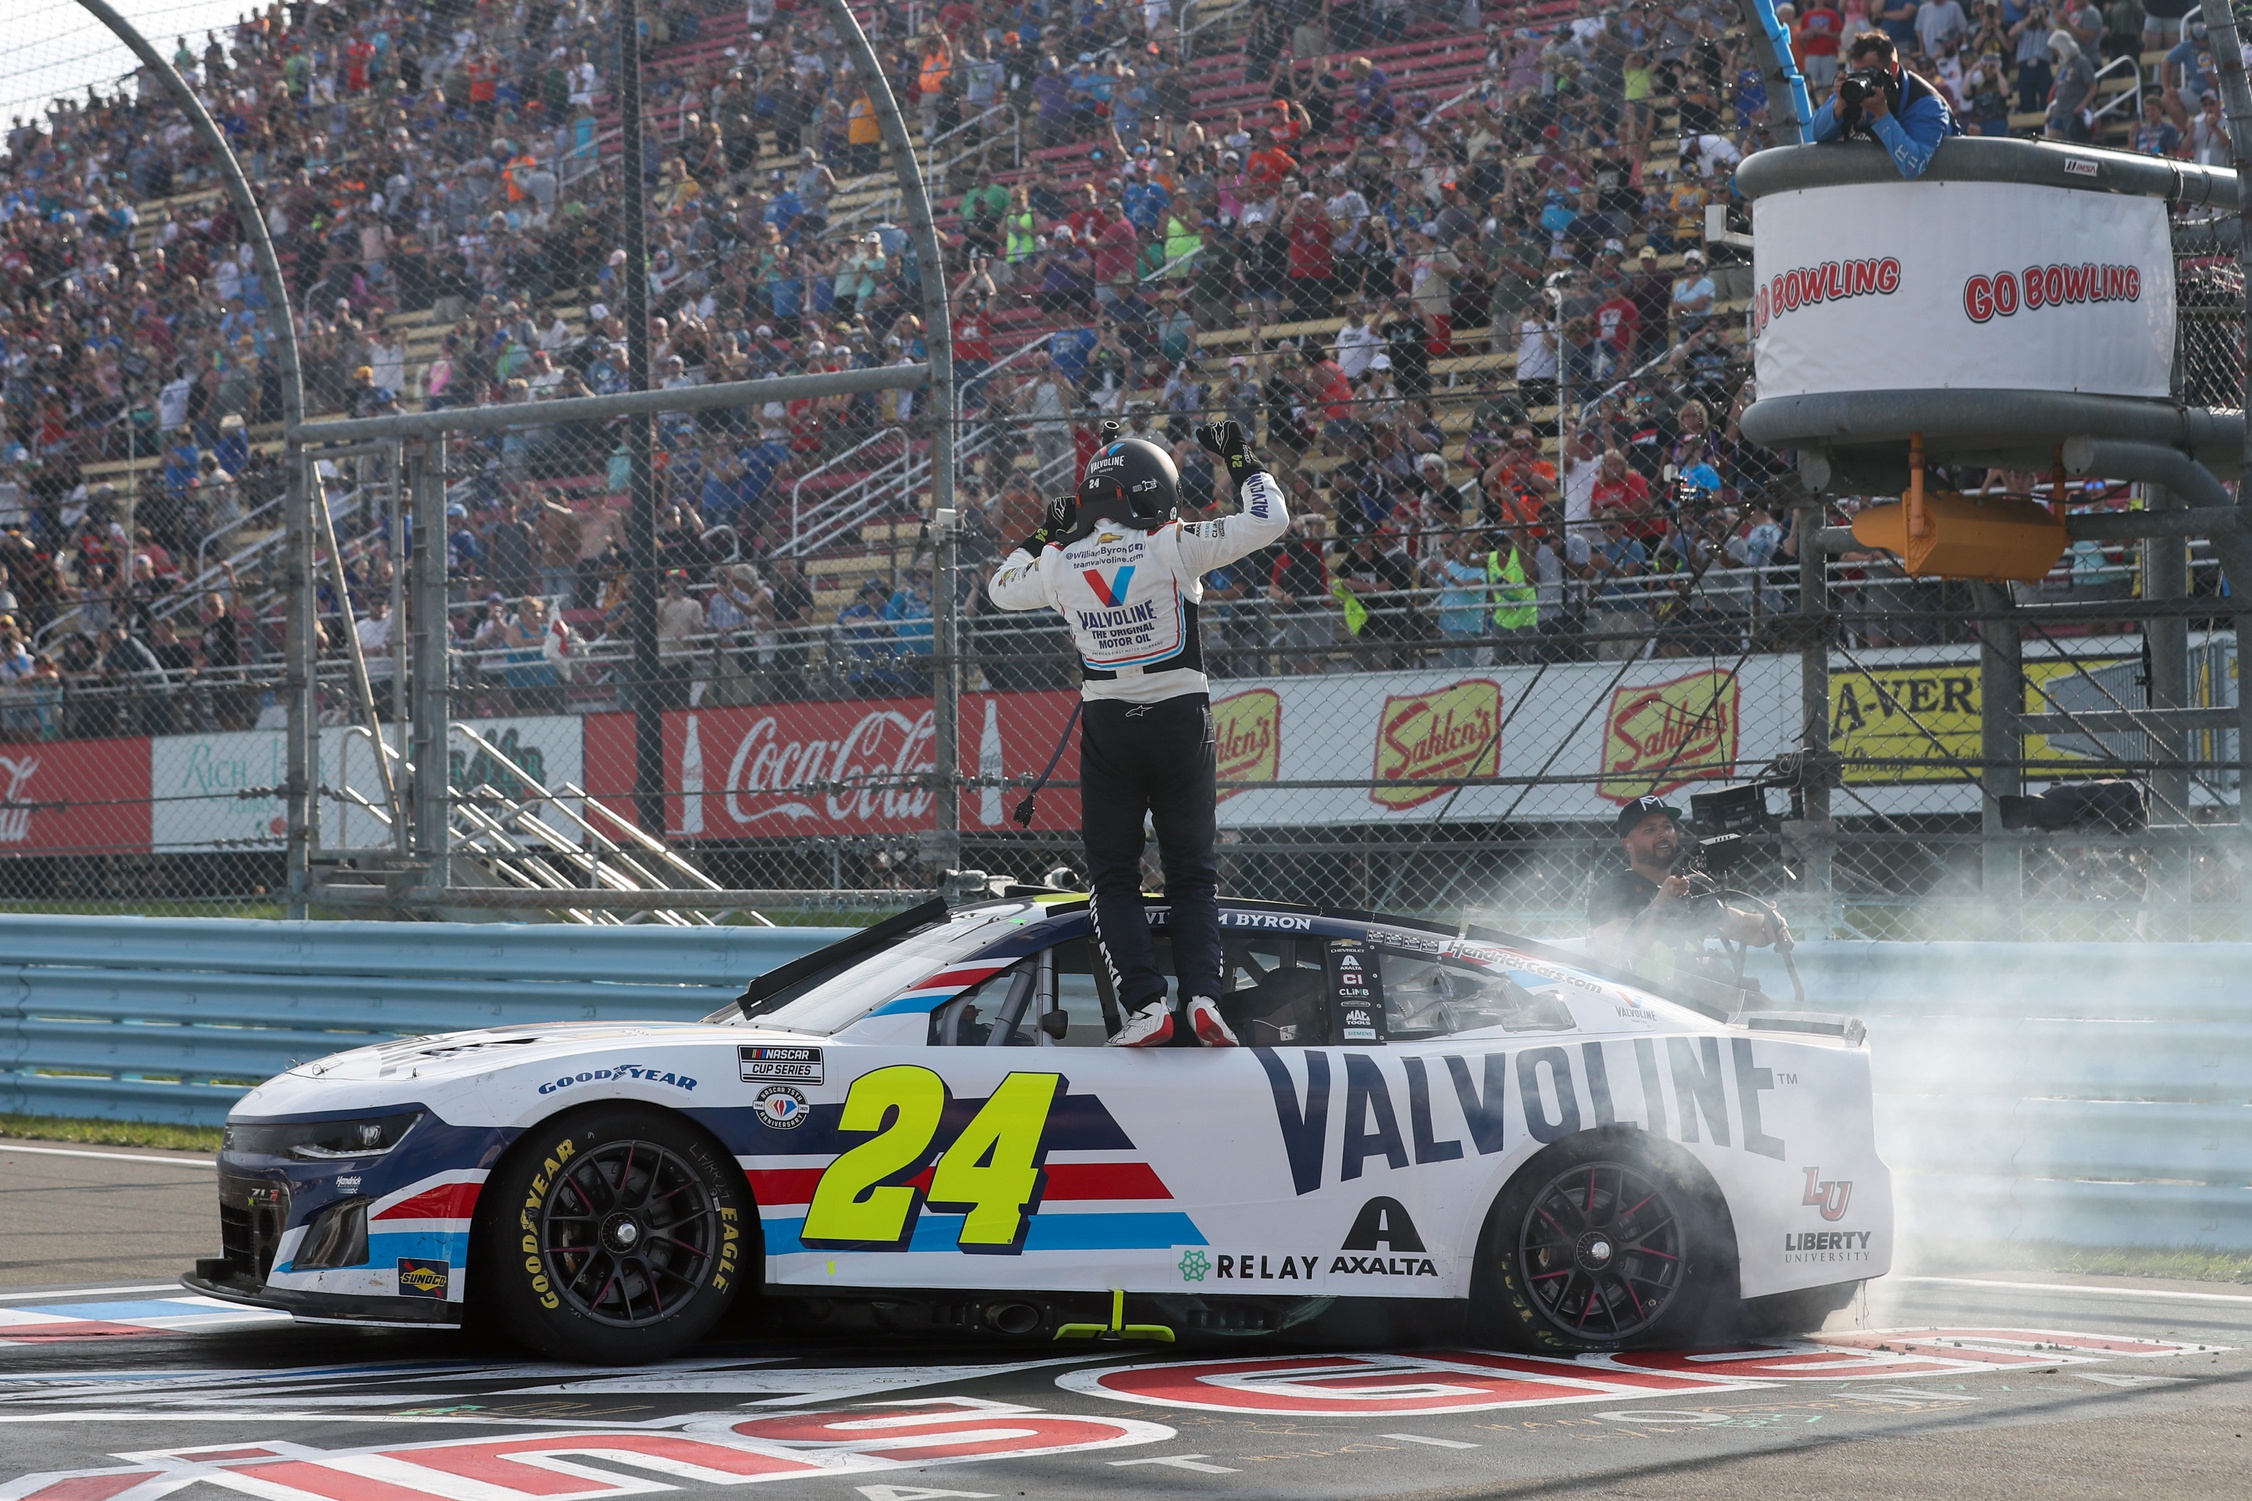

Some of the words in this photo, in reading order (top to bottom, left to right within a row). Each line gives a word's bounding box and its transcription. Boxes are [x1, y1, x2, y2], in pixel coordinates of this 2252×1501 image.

[1771, 256, 1901, 319] BOWLING
[1963, 270, 2020, 324] GO
[2021, 261, 2141, 311] BOWLING
[1090, 455, 1125, 474] VALVOLINE
[1231, 454, 1243, 468] 24
[1089, 478, 1100, 489] 24
[1035, 528, 1048, 543] 24
[1076, 599, 1157, 630] VALVOLINE
[1092, 629, 1107, 640] THE
[1110, 622, 1155, 638] ORIGINAL
[1098, 636, 1133, 649] MOTOR
[1135, 633, 1152, 644] OIL
[1382, 701, 1492, 779] Sahlen's
[1234, 912, 1312, 931] BYRON
[1446, 940, 1603, 994] HendrickCars.com
[1343, 973, 1364, 985] CI
[1346, 1010, 1371, 1021] MAC
[1615, 1004, 1657, 1022] VALVOLINE
[1140, 1020, 1152, 1033] 24
[765, 1049, 810, 1060] NASCAR
[752, 1063, 774, 1074] CUP
[775, 1064, 812, 1075] SERIES
[760, 1087, 786, 1099] NASCAR
[787, 1087, 803, 1102] 75TH
[759, 1111, 803, 1128] ANNIVERSARY
[1252, 1036, 1786, 1196] VALVOLINE
[799, 1063, 1070, 1256] 24
[335, 1175, 363, 1187] Hendrick
[1785, 1230, 1872, 1251] LIBERTY
[712, 1206, 739, 1295] EAGLE
[1785, 1251, 1871, 1264] UNIVERSITY
[1216, 1254, 1320, 1280] RELAY
[1328, 1256, 1439, 1277] AXALTA
[402, 1272, 447, 1287] SUNOCO
